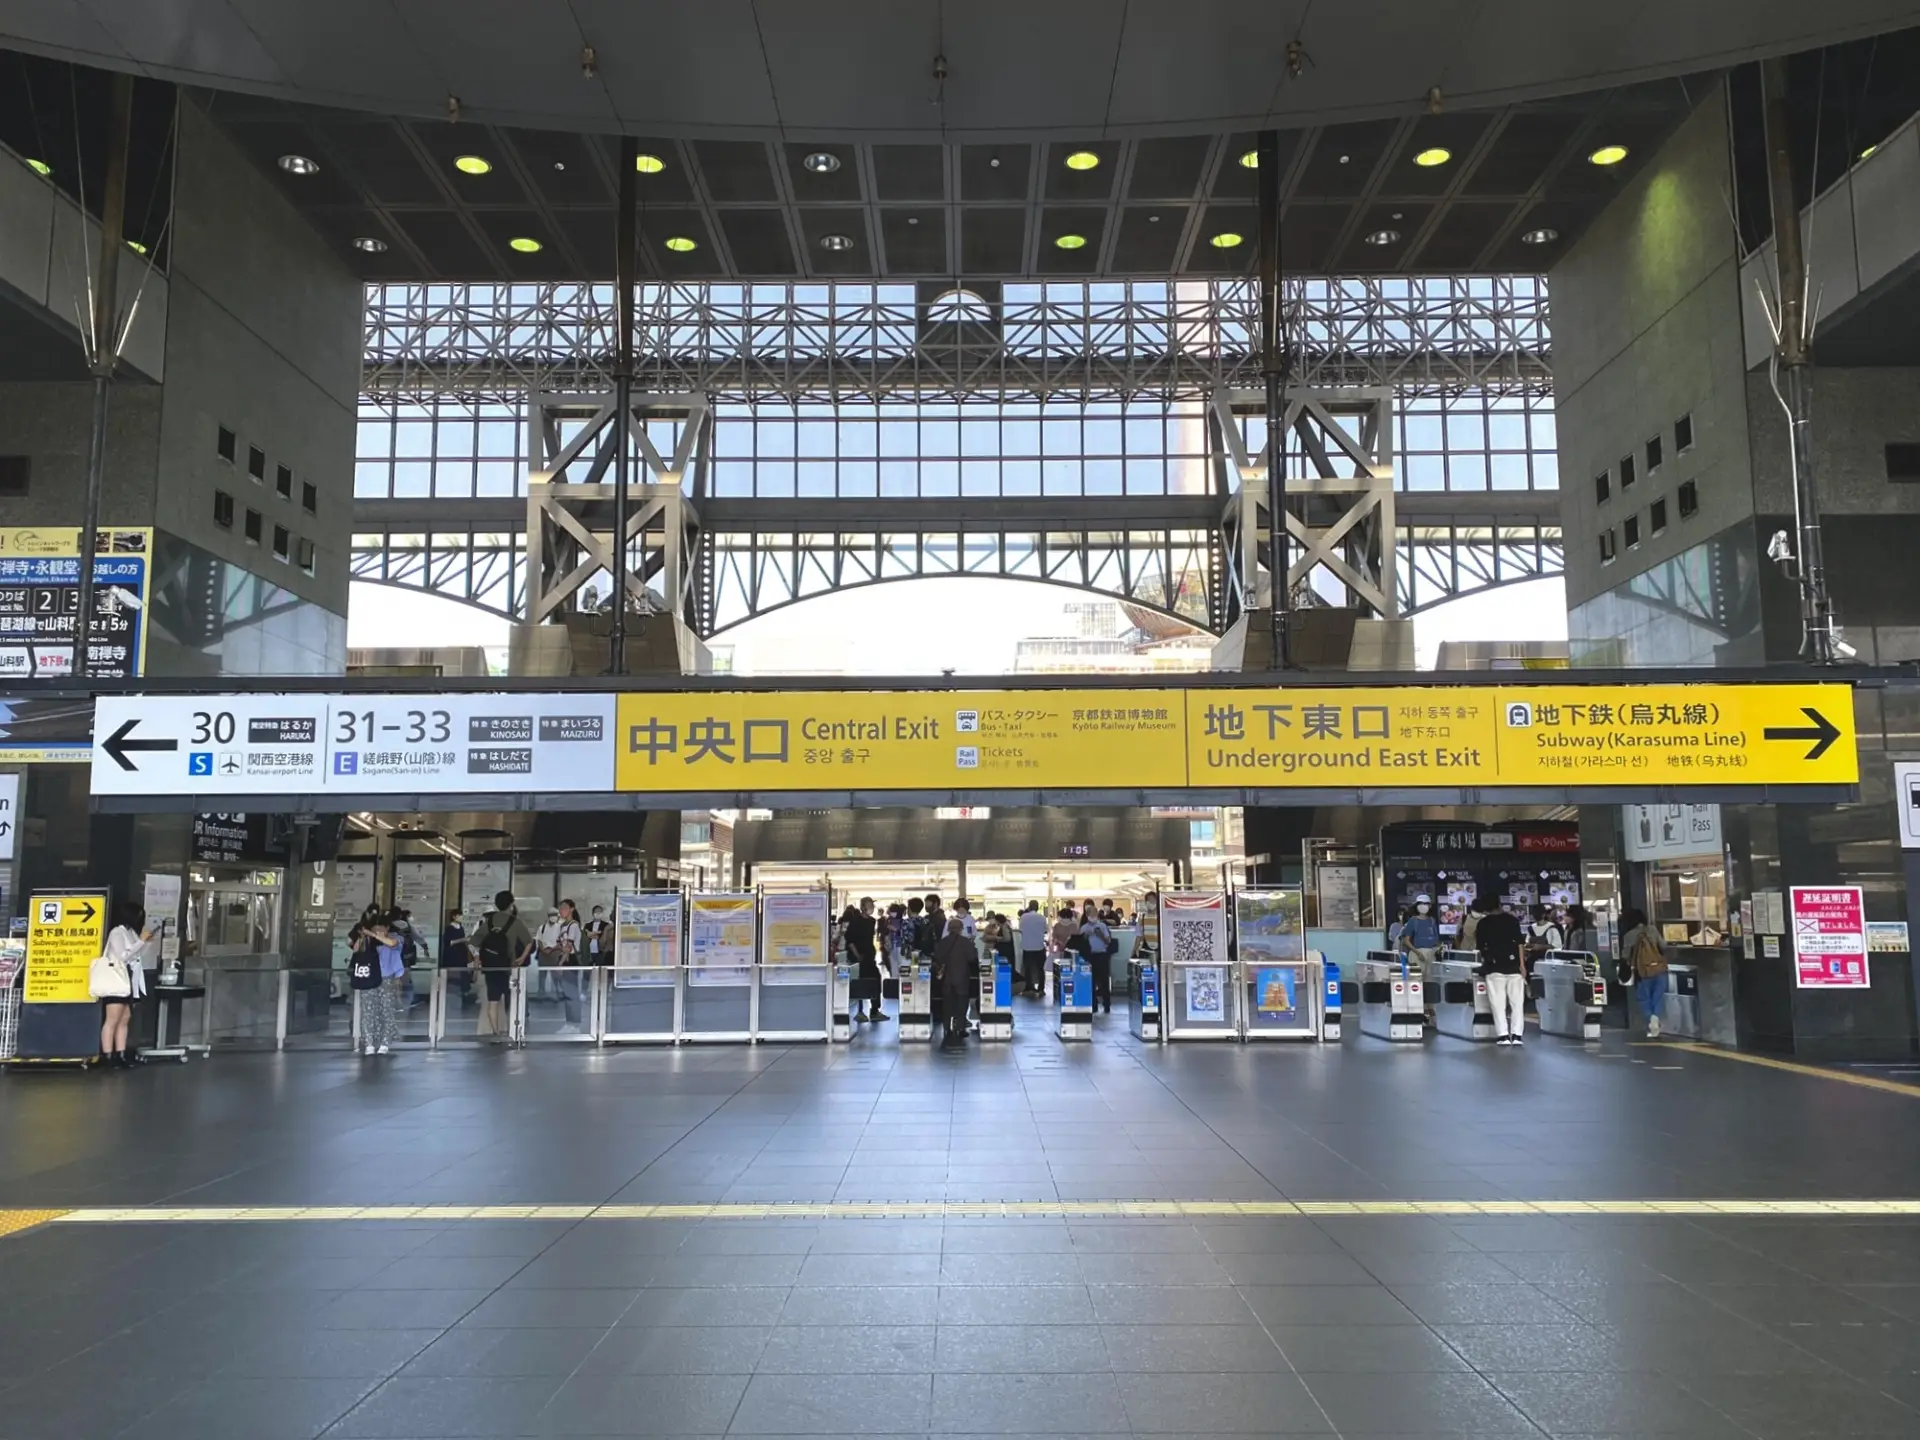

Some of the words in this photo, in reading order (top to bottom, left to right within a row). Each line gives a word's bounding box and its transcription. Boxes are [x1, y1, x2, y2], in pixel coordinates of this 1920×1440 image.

[40, 592, 52, 610] 2
[981, 710, 1059, 721] バス・タクシー
[1072, 708, 1168, 720] 京都鉄道博物館
[1399, 705, 1423, 719] 지하
[1427, 705, 1451, 719] 동쪽
[1456, 705, 1479, 719] 출구
[191, 711, 236, 744] 30
[280, 720, 312, 731] はるか
[490, 719, 530, 729] きのさき
[560, 718, 601, 729] まいづる
[1101, 721, 1136, 731] Railway
[1138, 721, 1176, 730] Museum
[1204, 703, 1390, 740] 地下東口
[560, 729, 600, 739] MAIZURU
[801, 715, 887, 741] Central
[895, 717, 939, 740] Exit
[1400, 726, 1451, 739] 地下东口
[279, 731, 312, 741] HARUKA
[490, 730, 530, 739] KINOSAKI
[1704, 731, 1747, 748] Line)
[629, 716, 789, 766] 中央口
[489, 751, 529, 762] はしだて
[803, 748, 833, 764] 중앙
[840, 748, 871, 764] 출구
[959, 749, 975, 758] Rail
[981, 746, 1023, 758] Tickets
[194, 755, 207, 773] S
[247, 752, 314, 766] 関西空港線
[340, 755, 352, 772] E
[958, 758, 976, 767] Pass
[1207, 747, 1371, 773] Underground
[1380, 748, 1429, 767] East
[1436, 747, 1481, 767] Exit
[247, 767, 297, 777] Kansai-airport
[298, 767, 314, 775] Line
[423, 767, 440, 775] Line
[489, 762, 529, 772] HASHIDATE
[193, 821, 204, 835] JR
[205, 823, 248, 840] Information
[1692, 818, 1711, 832] Pass
[354, 963, 371, 978] Lee
